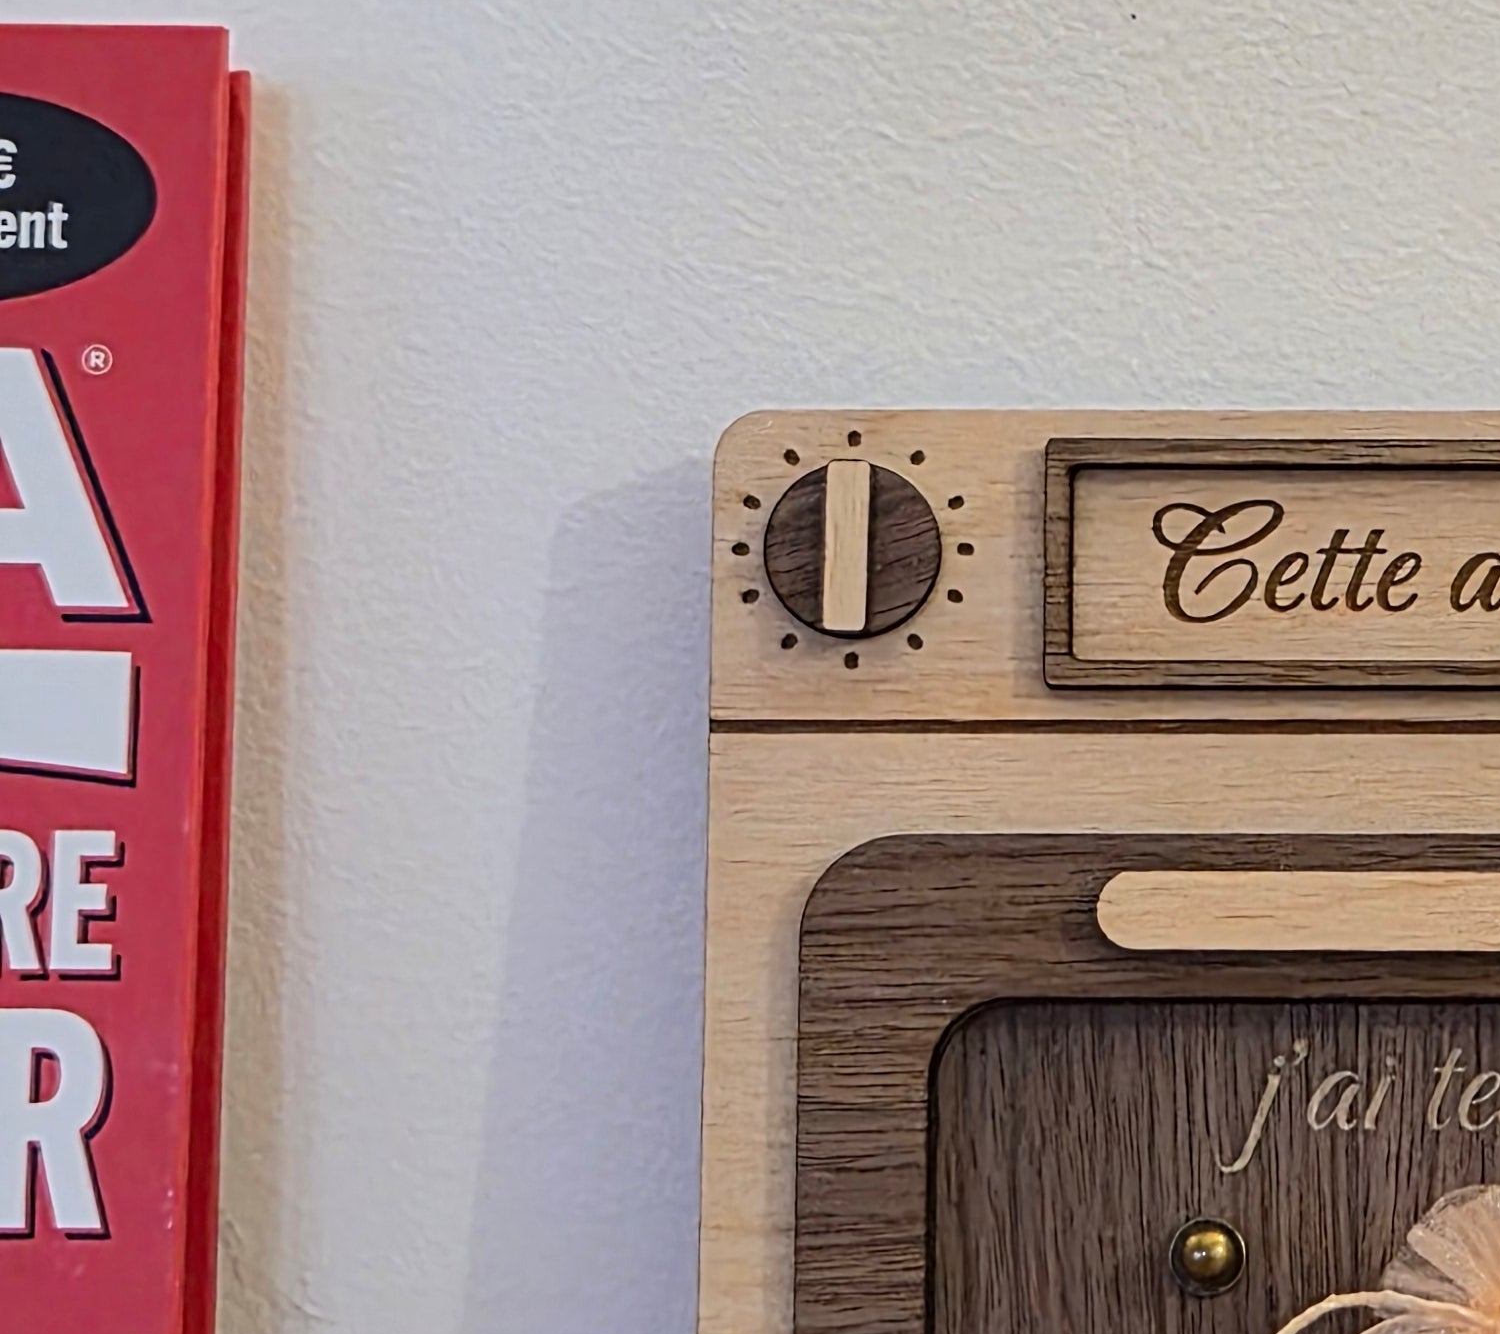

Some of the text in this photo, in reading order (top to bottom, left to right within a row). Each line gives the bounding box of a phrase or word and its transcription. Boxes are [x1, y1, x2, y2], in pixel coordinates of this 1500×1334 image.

[0, 202, 69, 250] ent
[1152, 498, 1422, 624] Cette
[0, 1008, 110, 1238] R
[1216, 1037, 1397, 1175] j'ai
